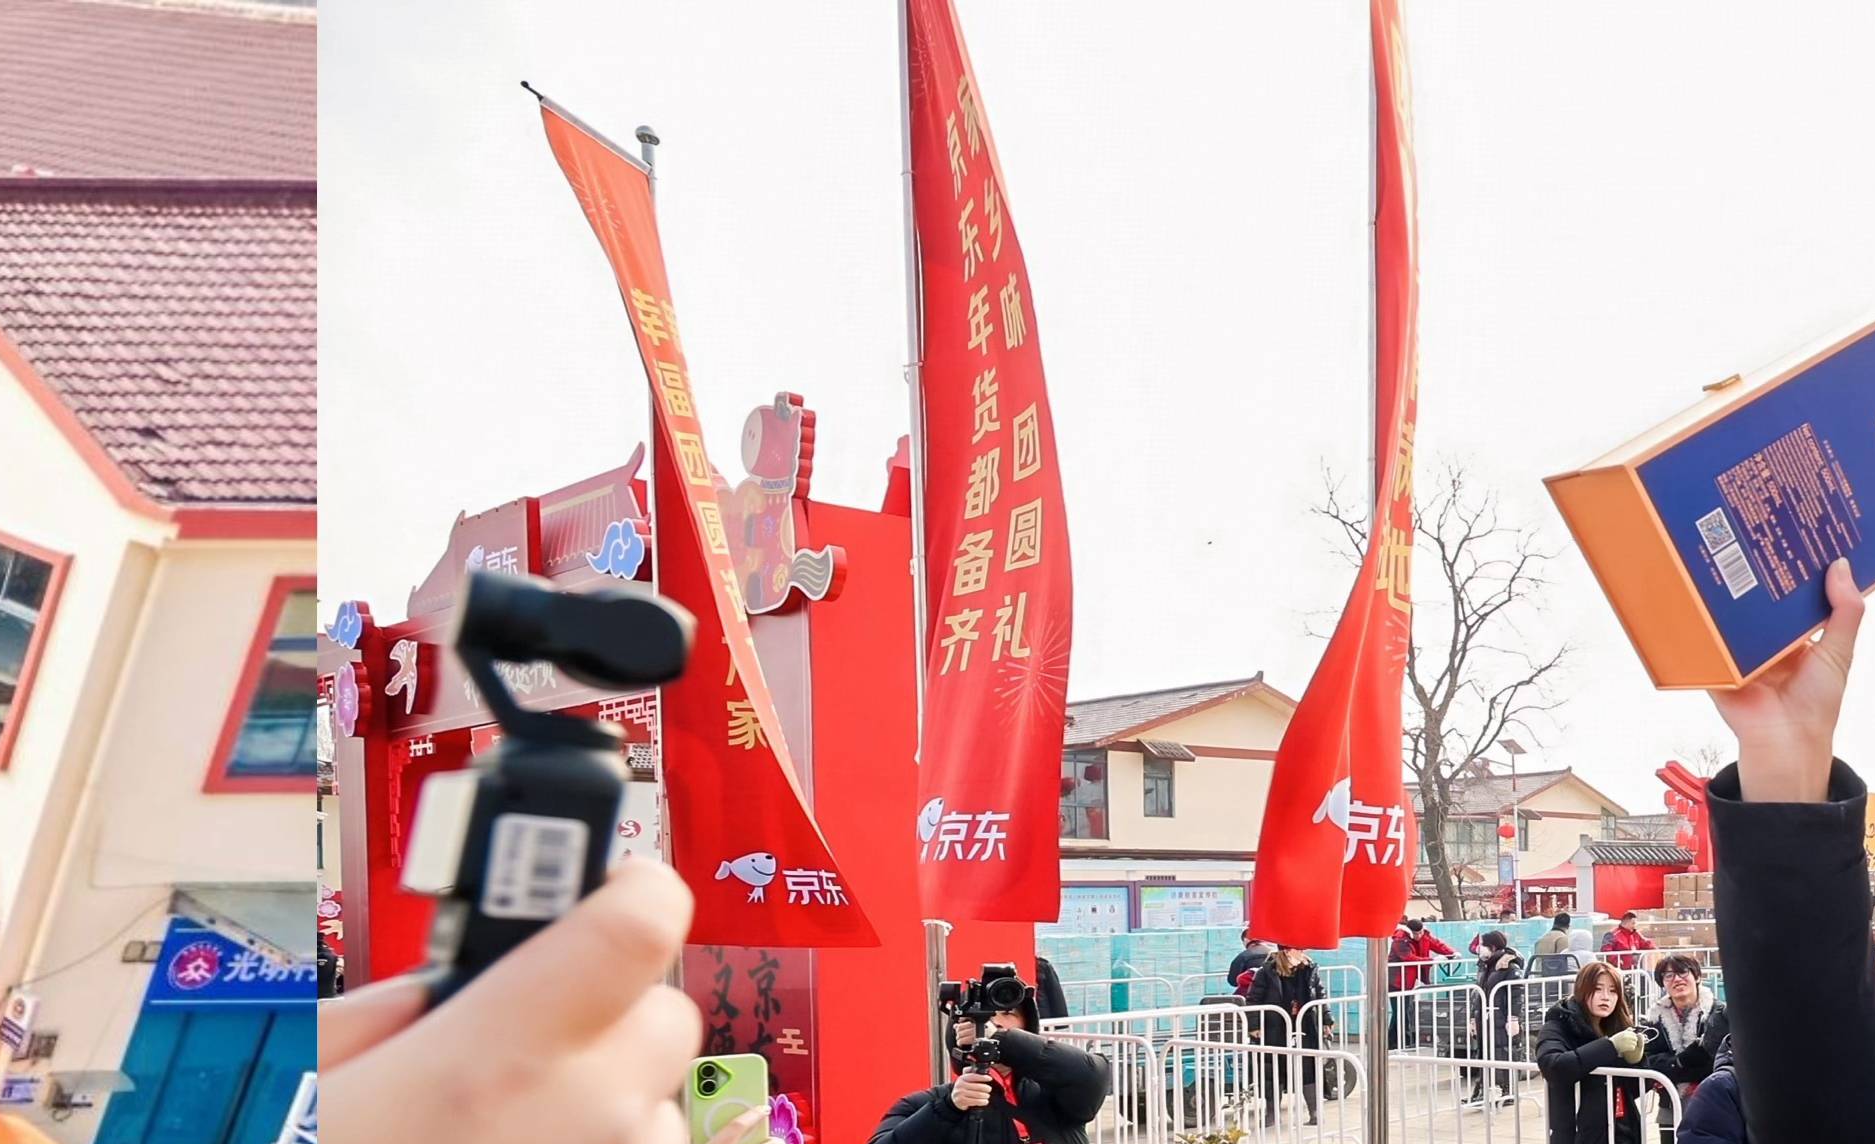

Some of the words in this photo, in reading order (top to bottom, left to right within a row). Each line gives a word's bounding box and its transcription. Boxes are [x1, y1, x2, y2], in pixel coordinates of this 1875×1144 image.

[941, 111, 1000, 674] 京东年货都备齐
[957, 74, 1025, 350] 家乡味
[991, 402, 1043, 661] 团圆礼
[784, 869, 849, 905] 京东
[935, 810, 1006, 862] 京东
